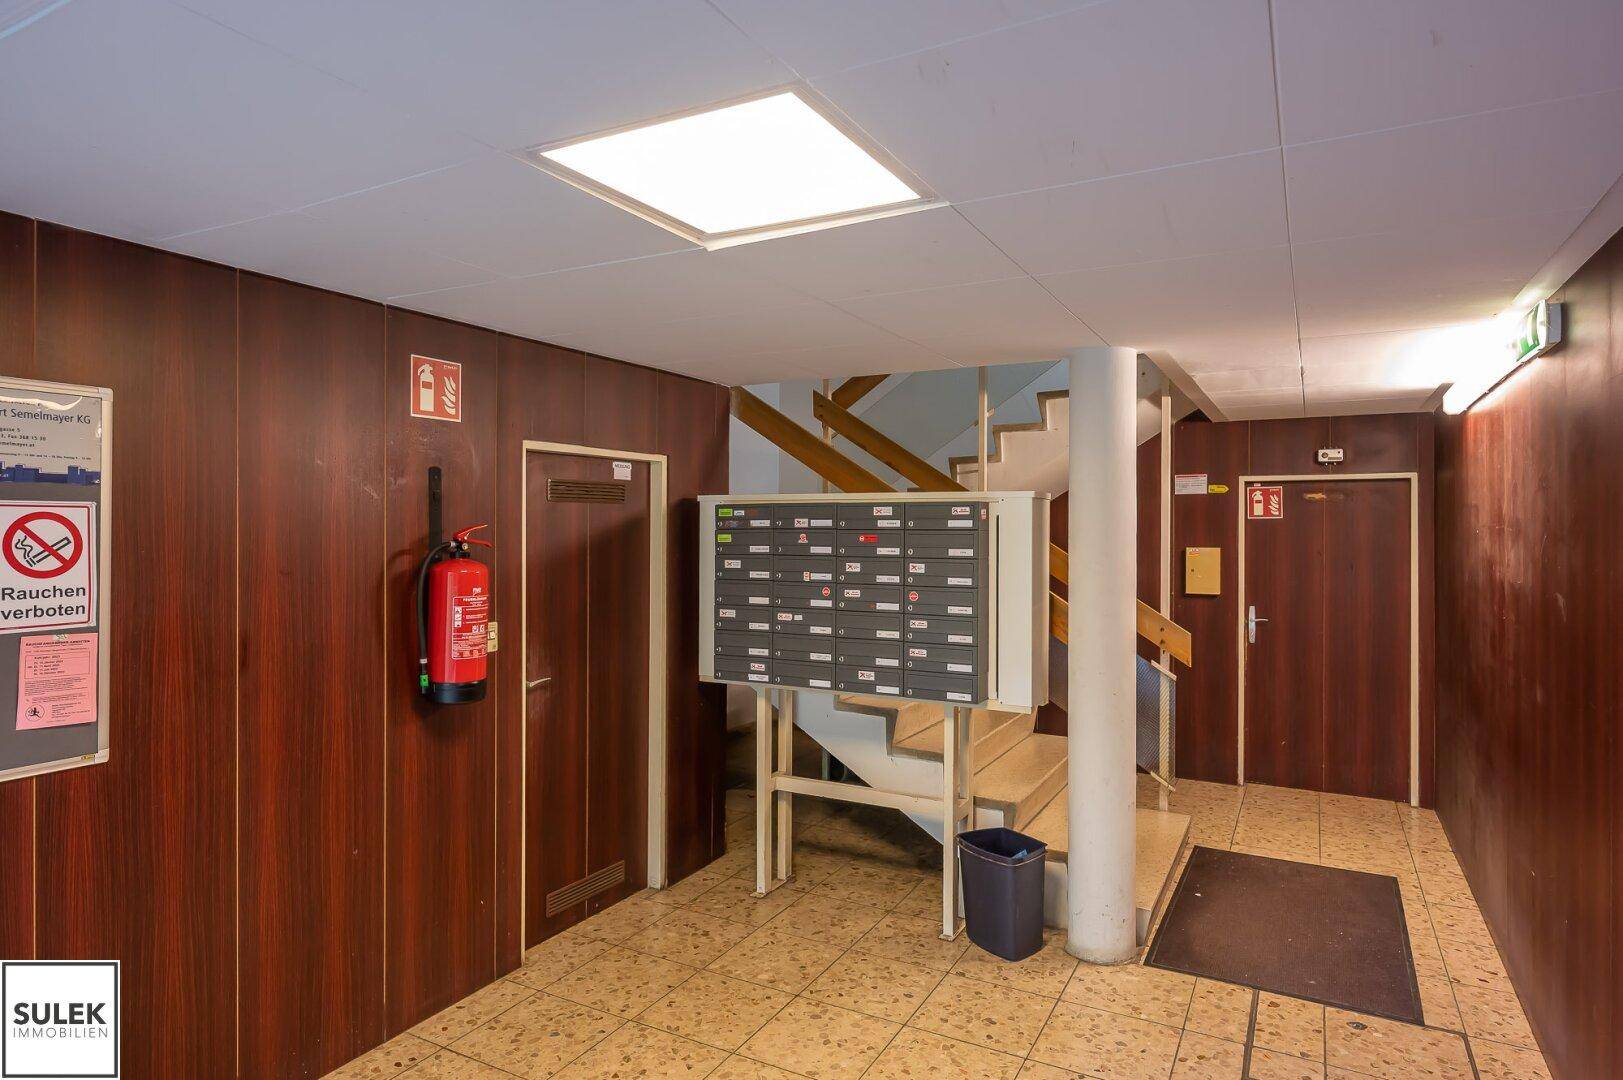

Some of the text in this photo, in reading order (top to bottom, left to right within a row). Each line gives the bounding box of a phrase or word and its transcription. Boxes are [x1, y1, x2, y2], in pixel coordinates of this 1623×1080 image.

[11, 408, 74, 424] Semelmayer
[77, 414, 91, 424] KG
[1, 585, 86, 600] Rauchen
[1, 604, 86, 620] verboten
